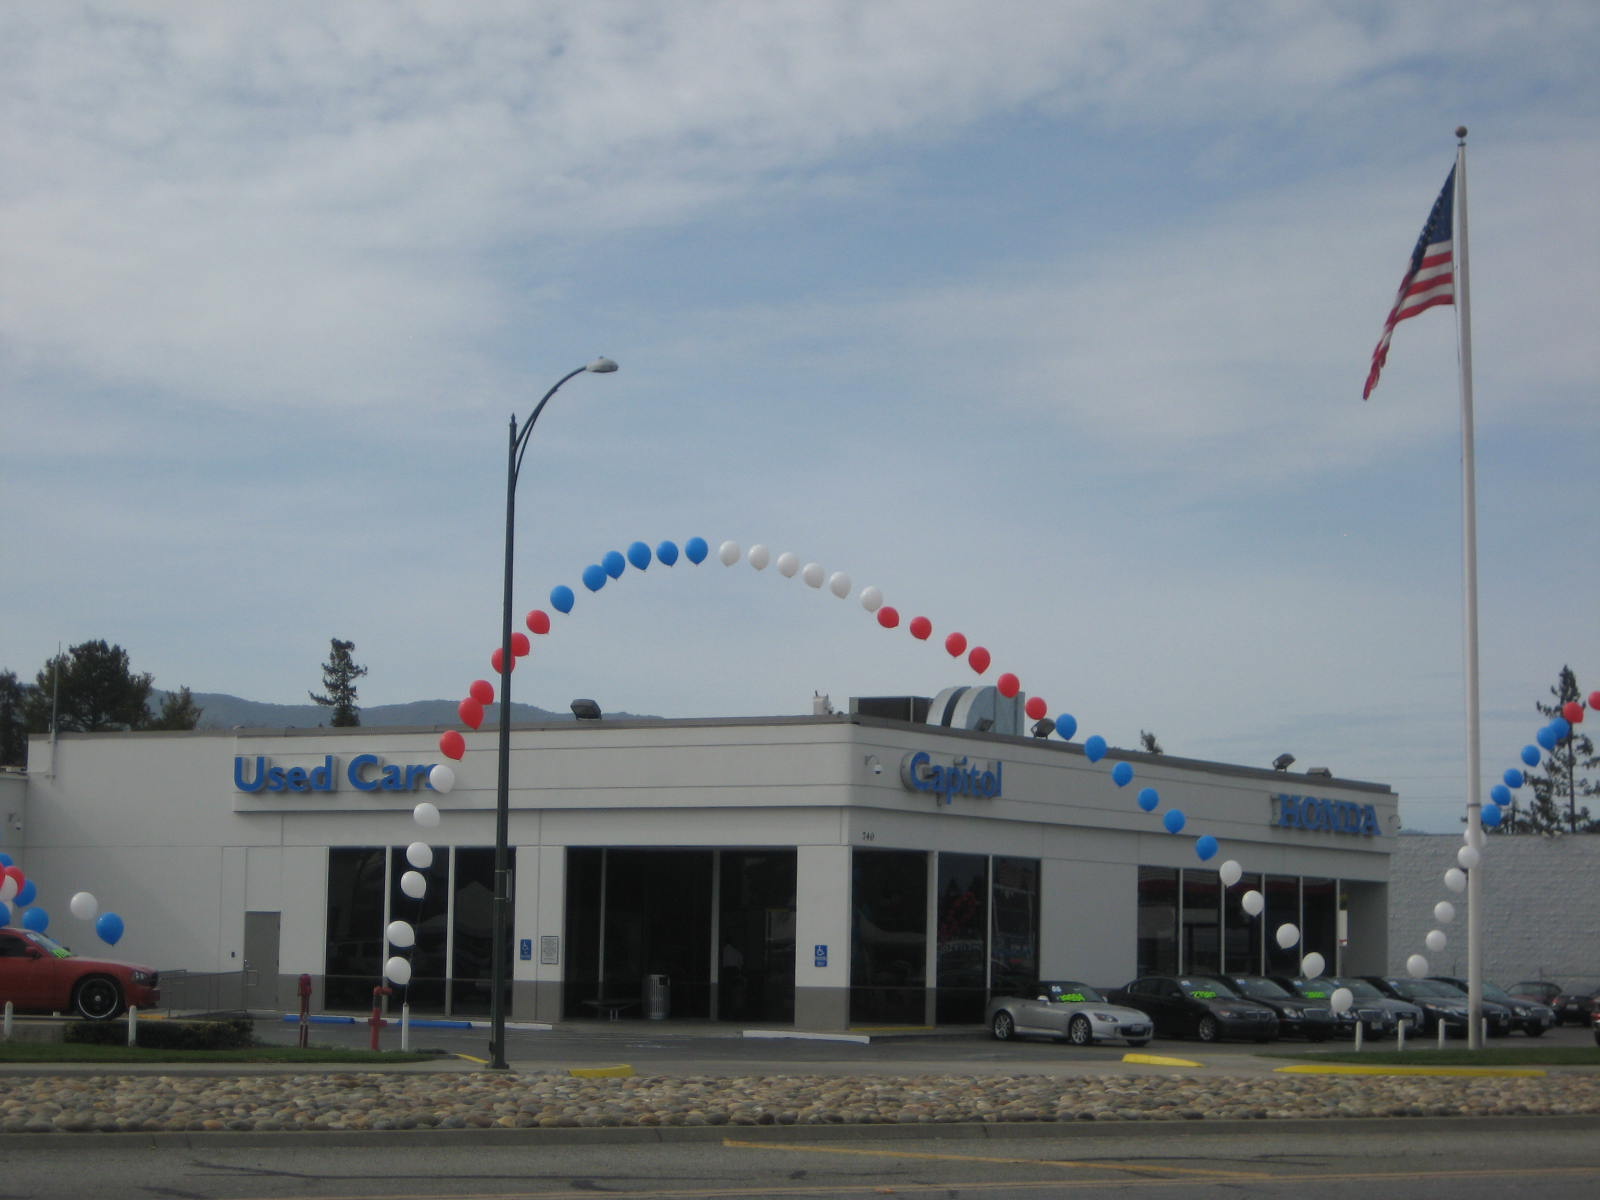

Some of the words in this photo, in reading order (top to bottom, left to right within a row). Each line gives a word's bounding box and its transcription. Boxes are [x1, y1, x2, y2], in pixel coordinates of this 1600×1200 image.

[234, 755, 332, 792] Used
[910, 752, 1002, 805] Capitol
[1278, 793, 1382, 835] HONDA
